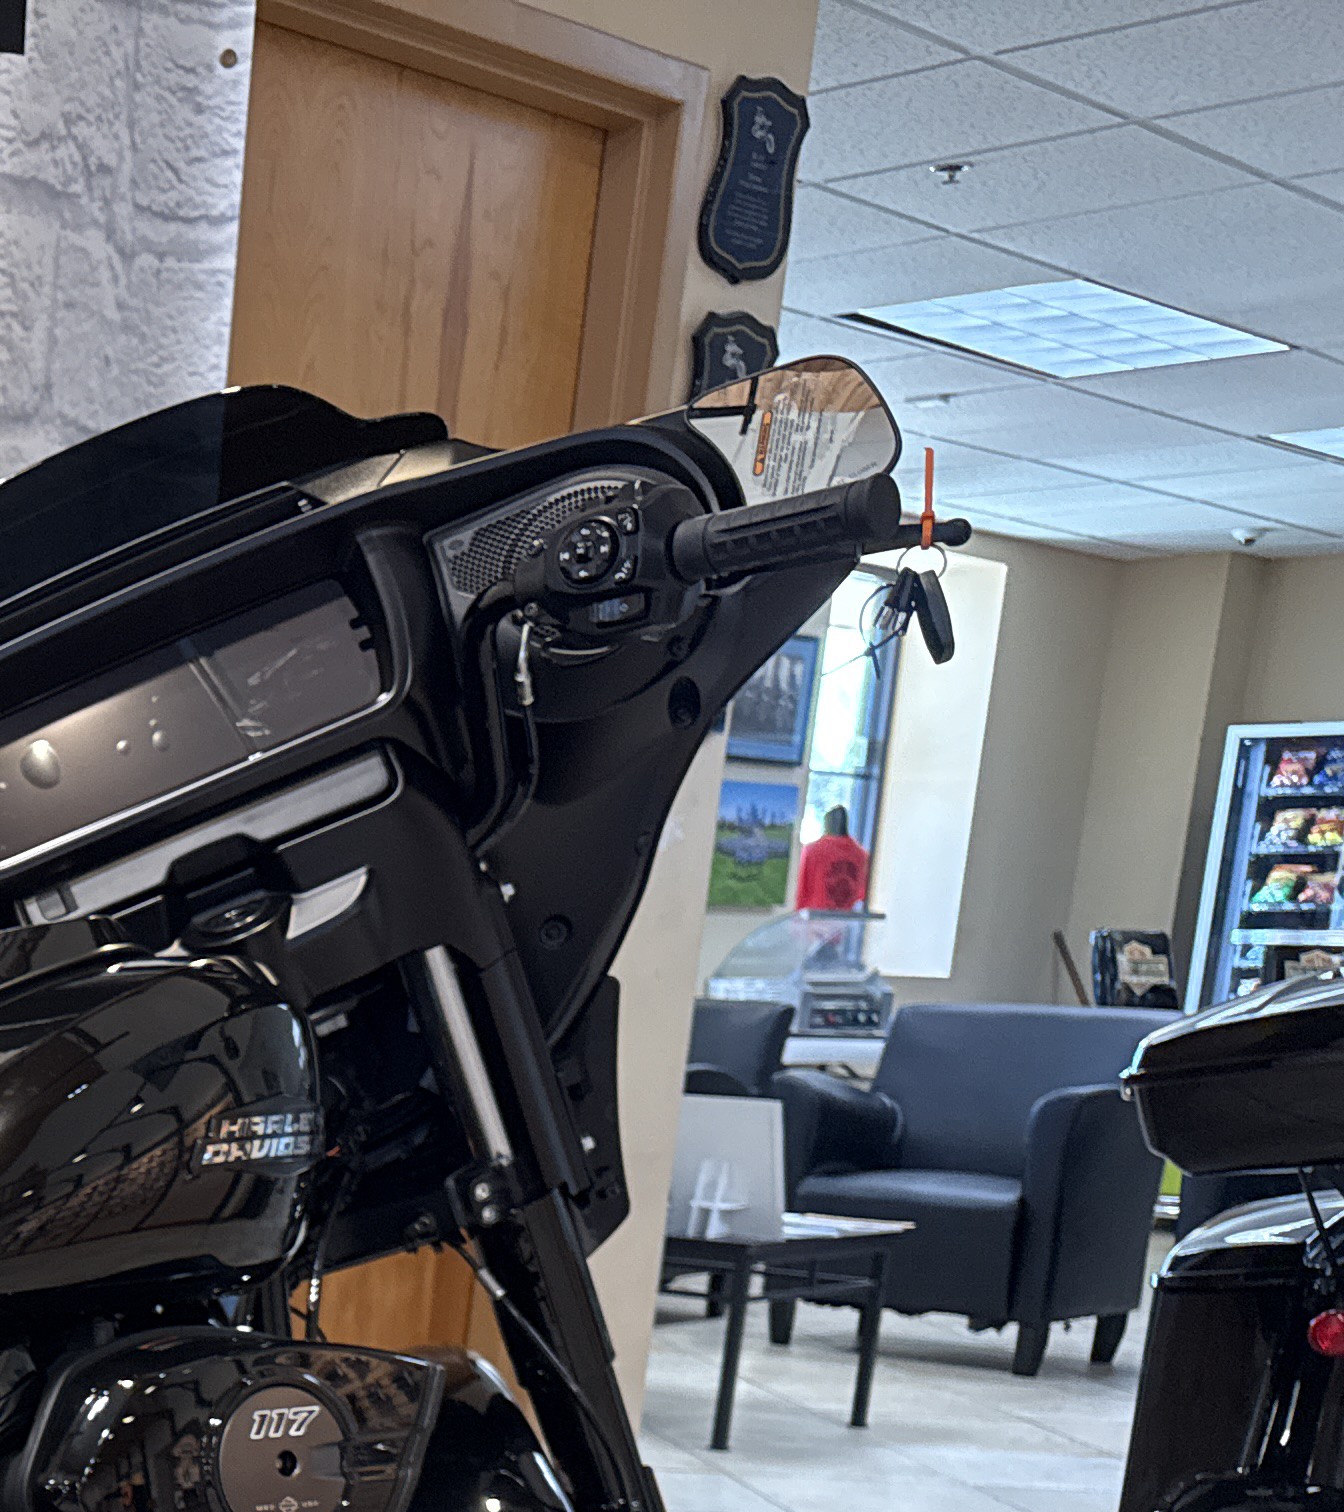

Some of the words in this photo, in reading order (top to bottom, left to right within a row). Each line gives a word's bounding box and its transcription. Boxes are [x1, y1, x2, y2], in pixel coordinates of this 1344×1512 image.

[217, 1111, 317, 1139] HARLE
[201, 1136, 312, 1165] DAVIDS
[249, 1404, 320, 1440] 117
